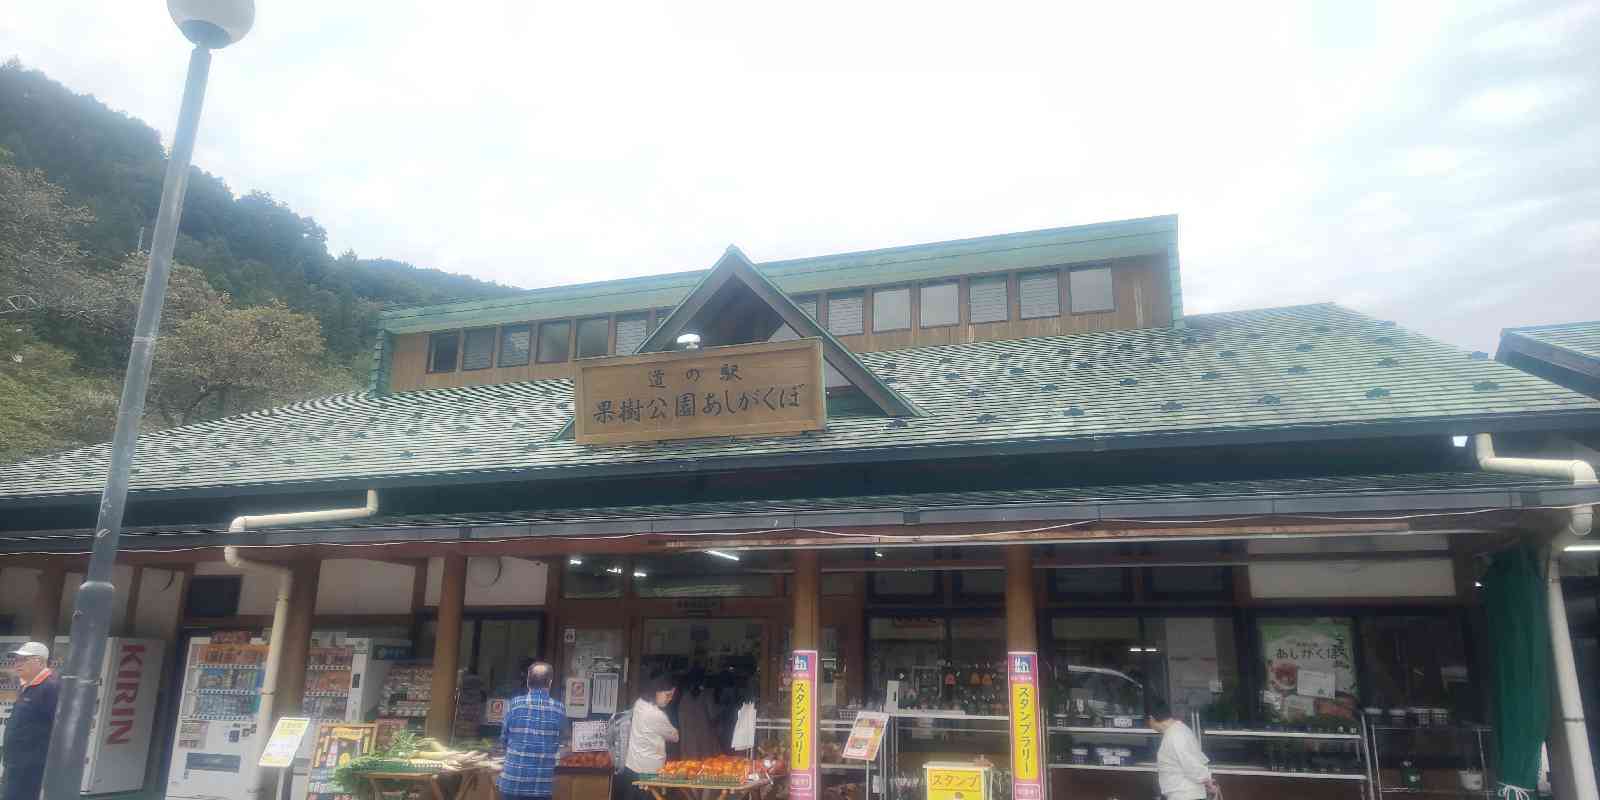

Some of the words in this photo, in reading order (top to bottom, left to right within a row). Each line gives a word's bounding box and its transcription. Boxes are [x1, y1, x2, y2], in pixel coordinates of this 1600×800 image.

[593, 383, 806, 424] 果樹公園あしがくぼ
[648, 363, 743, 389] 道の駅
[107, 645, 145, 744] KIRIN
[795, 682, 806, 764] スタンプラリー
[1019, 687, 1032, 775] スタンプラリー
